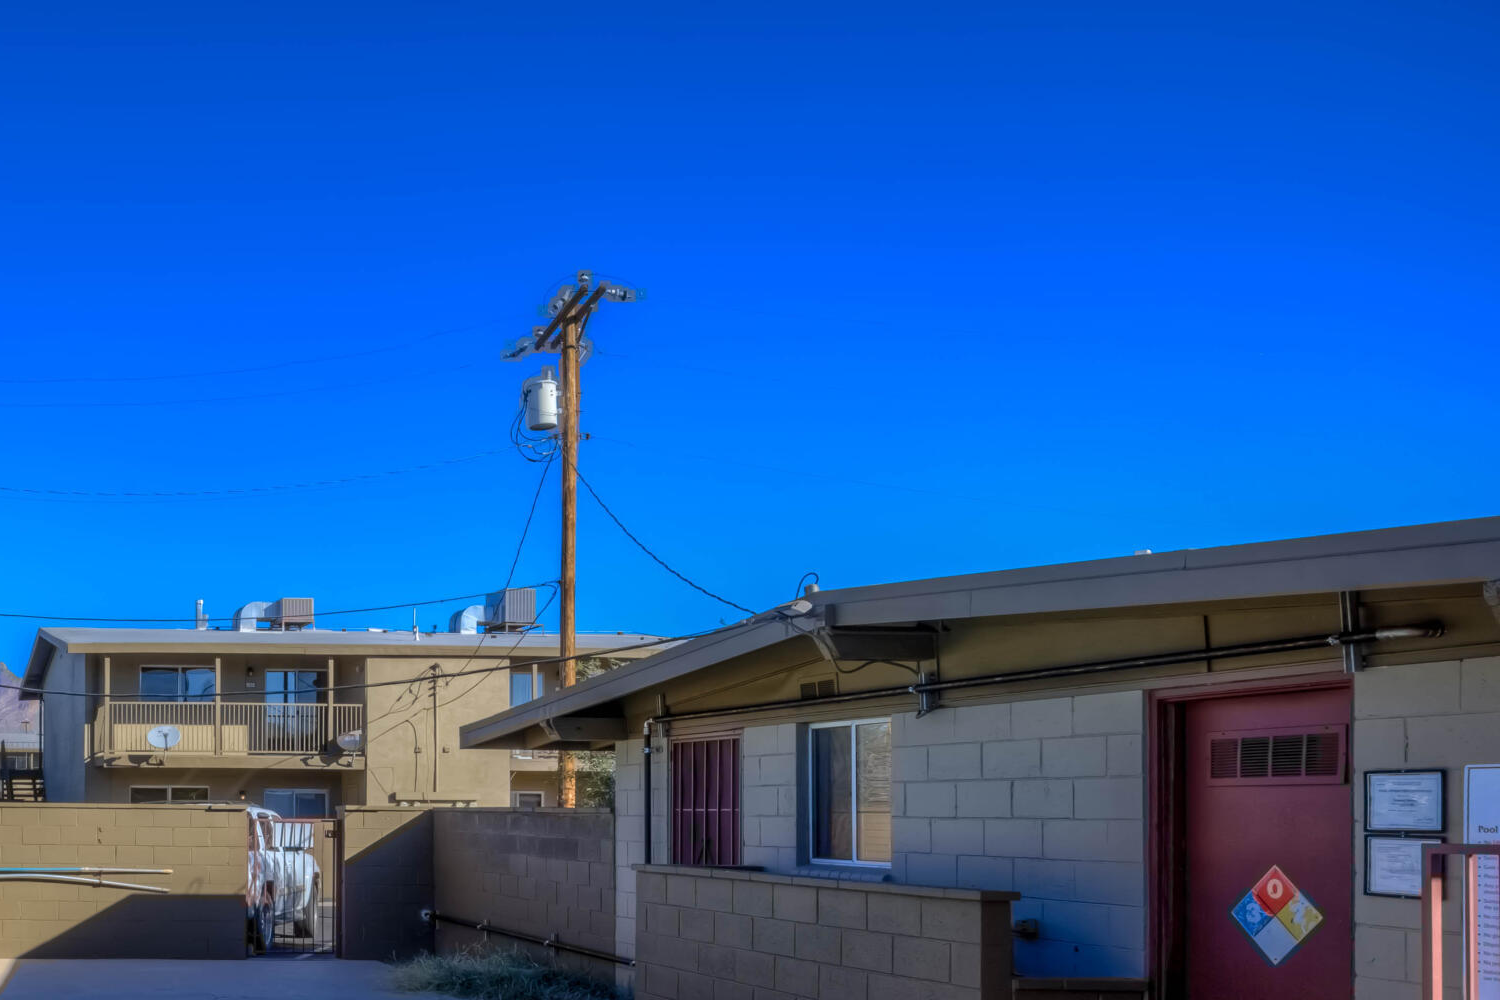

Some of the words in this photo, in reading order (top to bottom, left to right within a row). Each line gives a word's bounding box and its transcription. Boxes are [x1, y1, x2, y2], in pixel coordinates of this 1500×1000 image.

[1478, 825, 1498, 834] Pool
[1267, 879, 1283, 899] 0
[1246, 903, 1261, 923] 3
